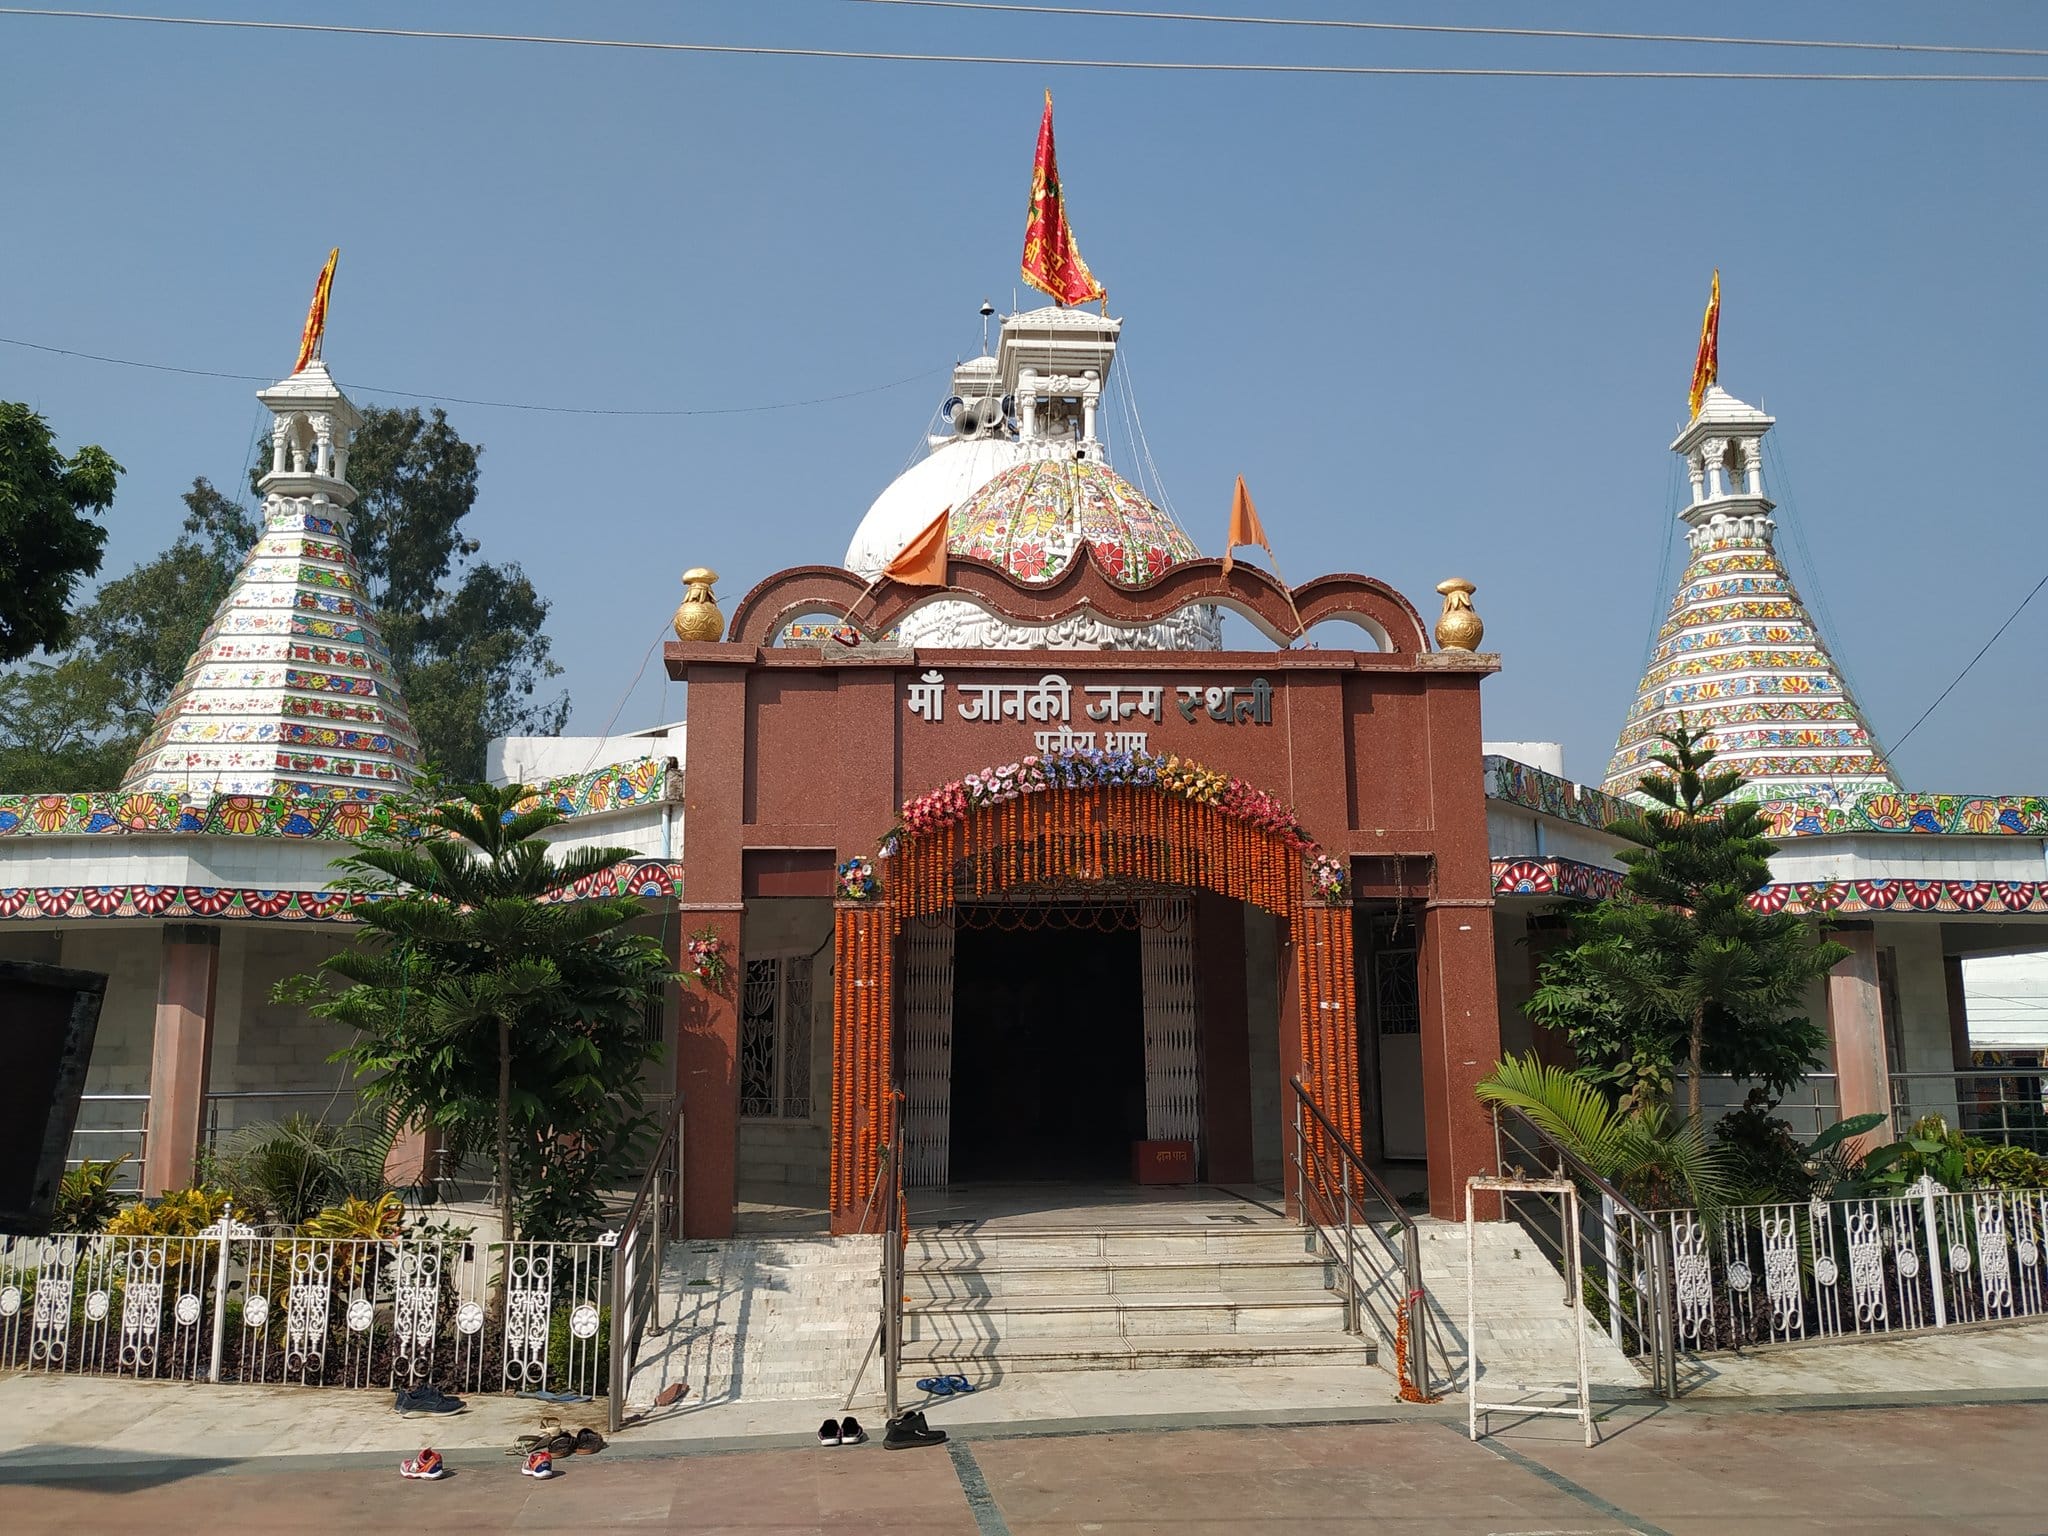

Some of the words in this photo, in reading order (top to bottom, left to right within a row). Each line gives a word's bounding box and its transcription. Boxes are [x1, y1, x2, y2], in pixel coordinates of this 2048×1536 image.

[1024, 237, 1040, 265] श्री
[1040, 254, 1067, 294] राम
[907, 669, 945, 721] माँ
[957, 674, 1072, 721] जानकी
[1084, 685, 1164, 722] जन्म
[1176, 677, 1273, 723] स्थली
[1104, 731, 1148, 757] धाम
[1156, 1151, 1171, 1162] दान
